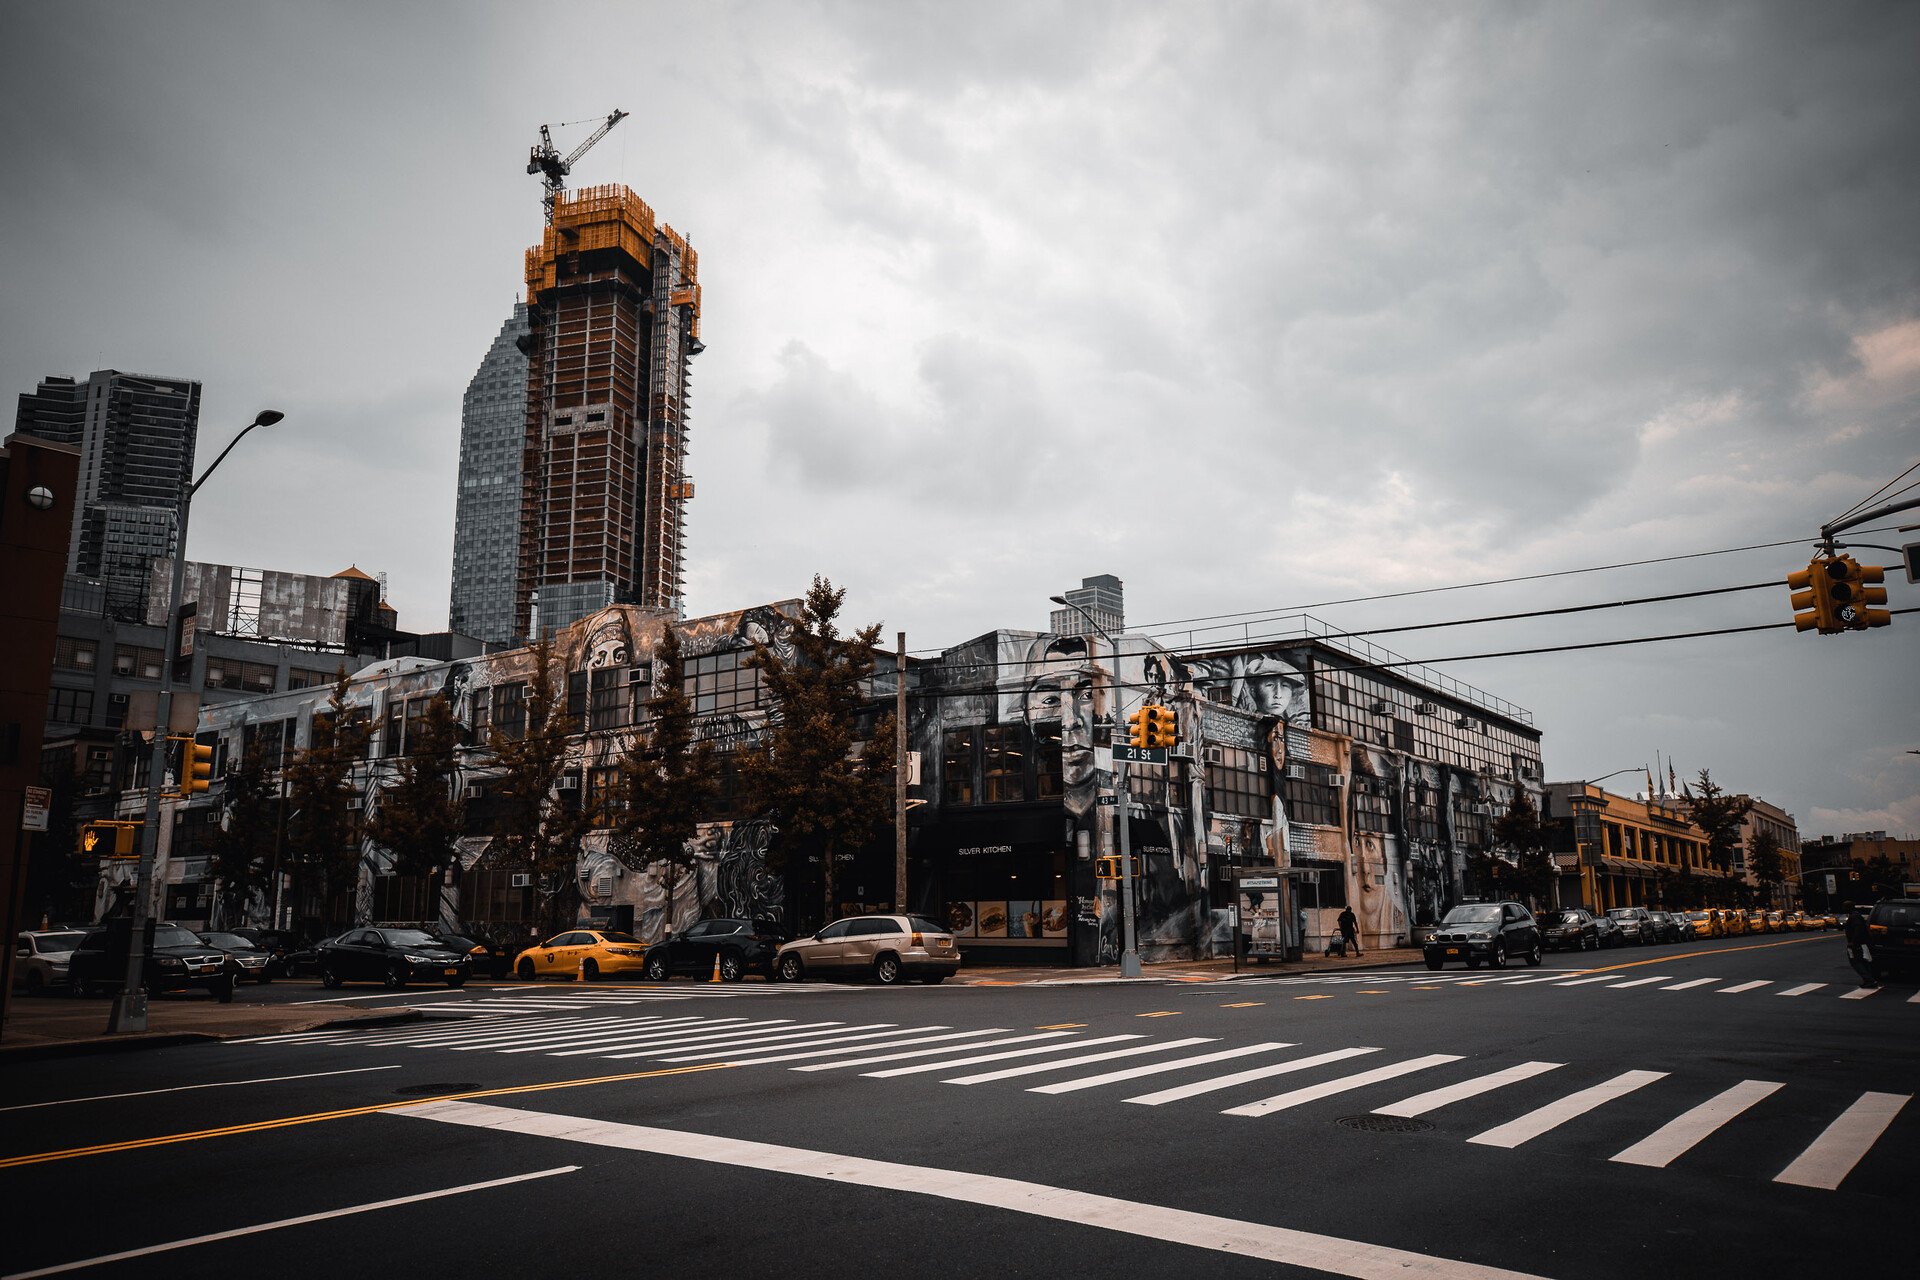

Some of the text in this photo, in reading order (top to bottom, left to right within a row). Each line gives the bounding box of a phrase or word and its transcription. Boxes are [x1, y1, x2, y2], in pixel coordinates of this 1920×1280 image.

[1127, 748, 1151, 760] 21 St
[959, 845, 1012, 855] SILVER KITCHEN
